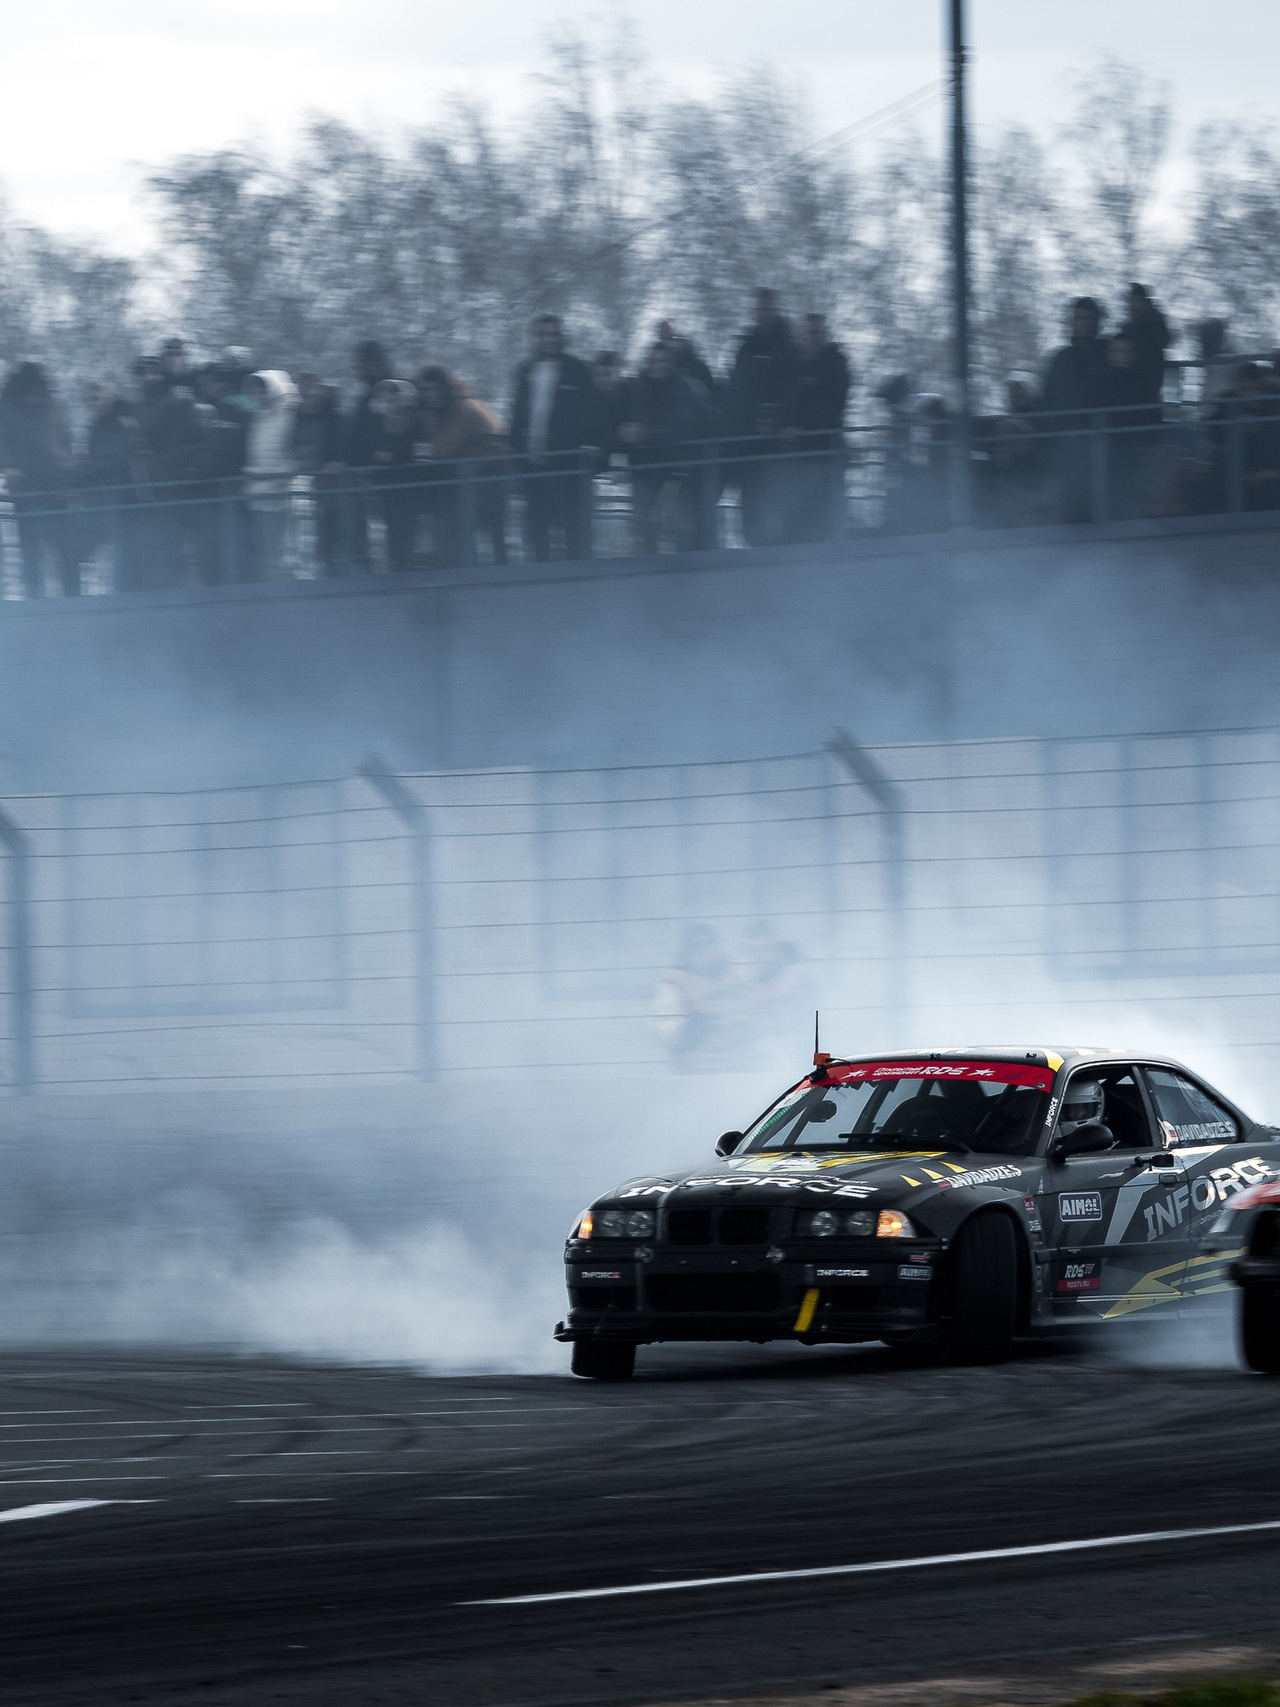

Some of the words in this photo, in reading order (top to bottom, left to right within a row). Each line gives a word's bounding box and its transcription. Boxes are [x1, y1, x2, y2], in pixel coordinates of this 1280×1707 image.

[919, 1066, 970, 1076] RDS
[1045, 1096, 1059, 1127] INFORCE
[619, 1177, 879, 1198] INFORCE
[1144, 1156, 1277, 1241] INFORCE
[1065, 1264, 1084, 1278] RDS
